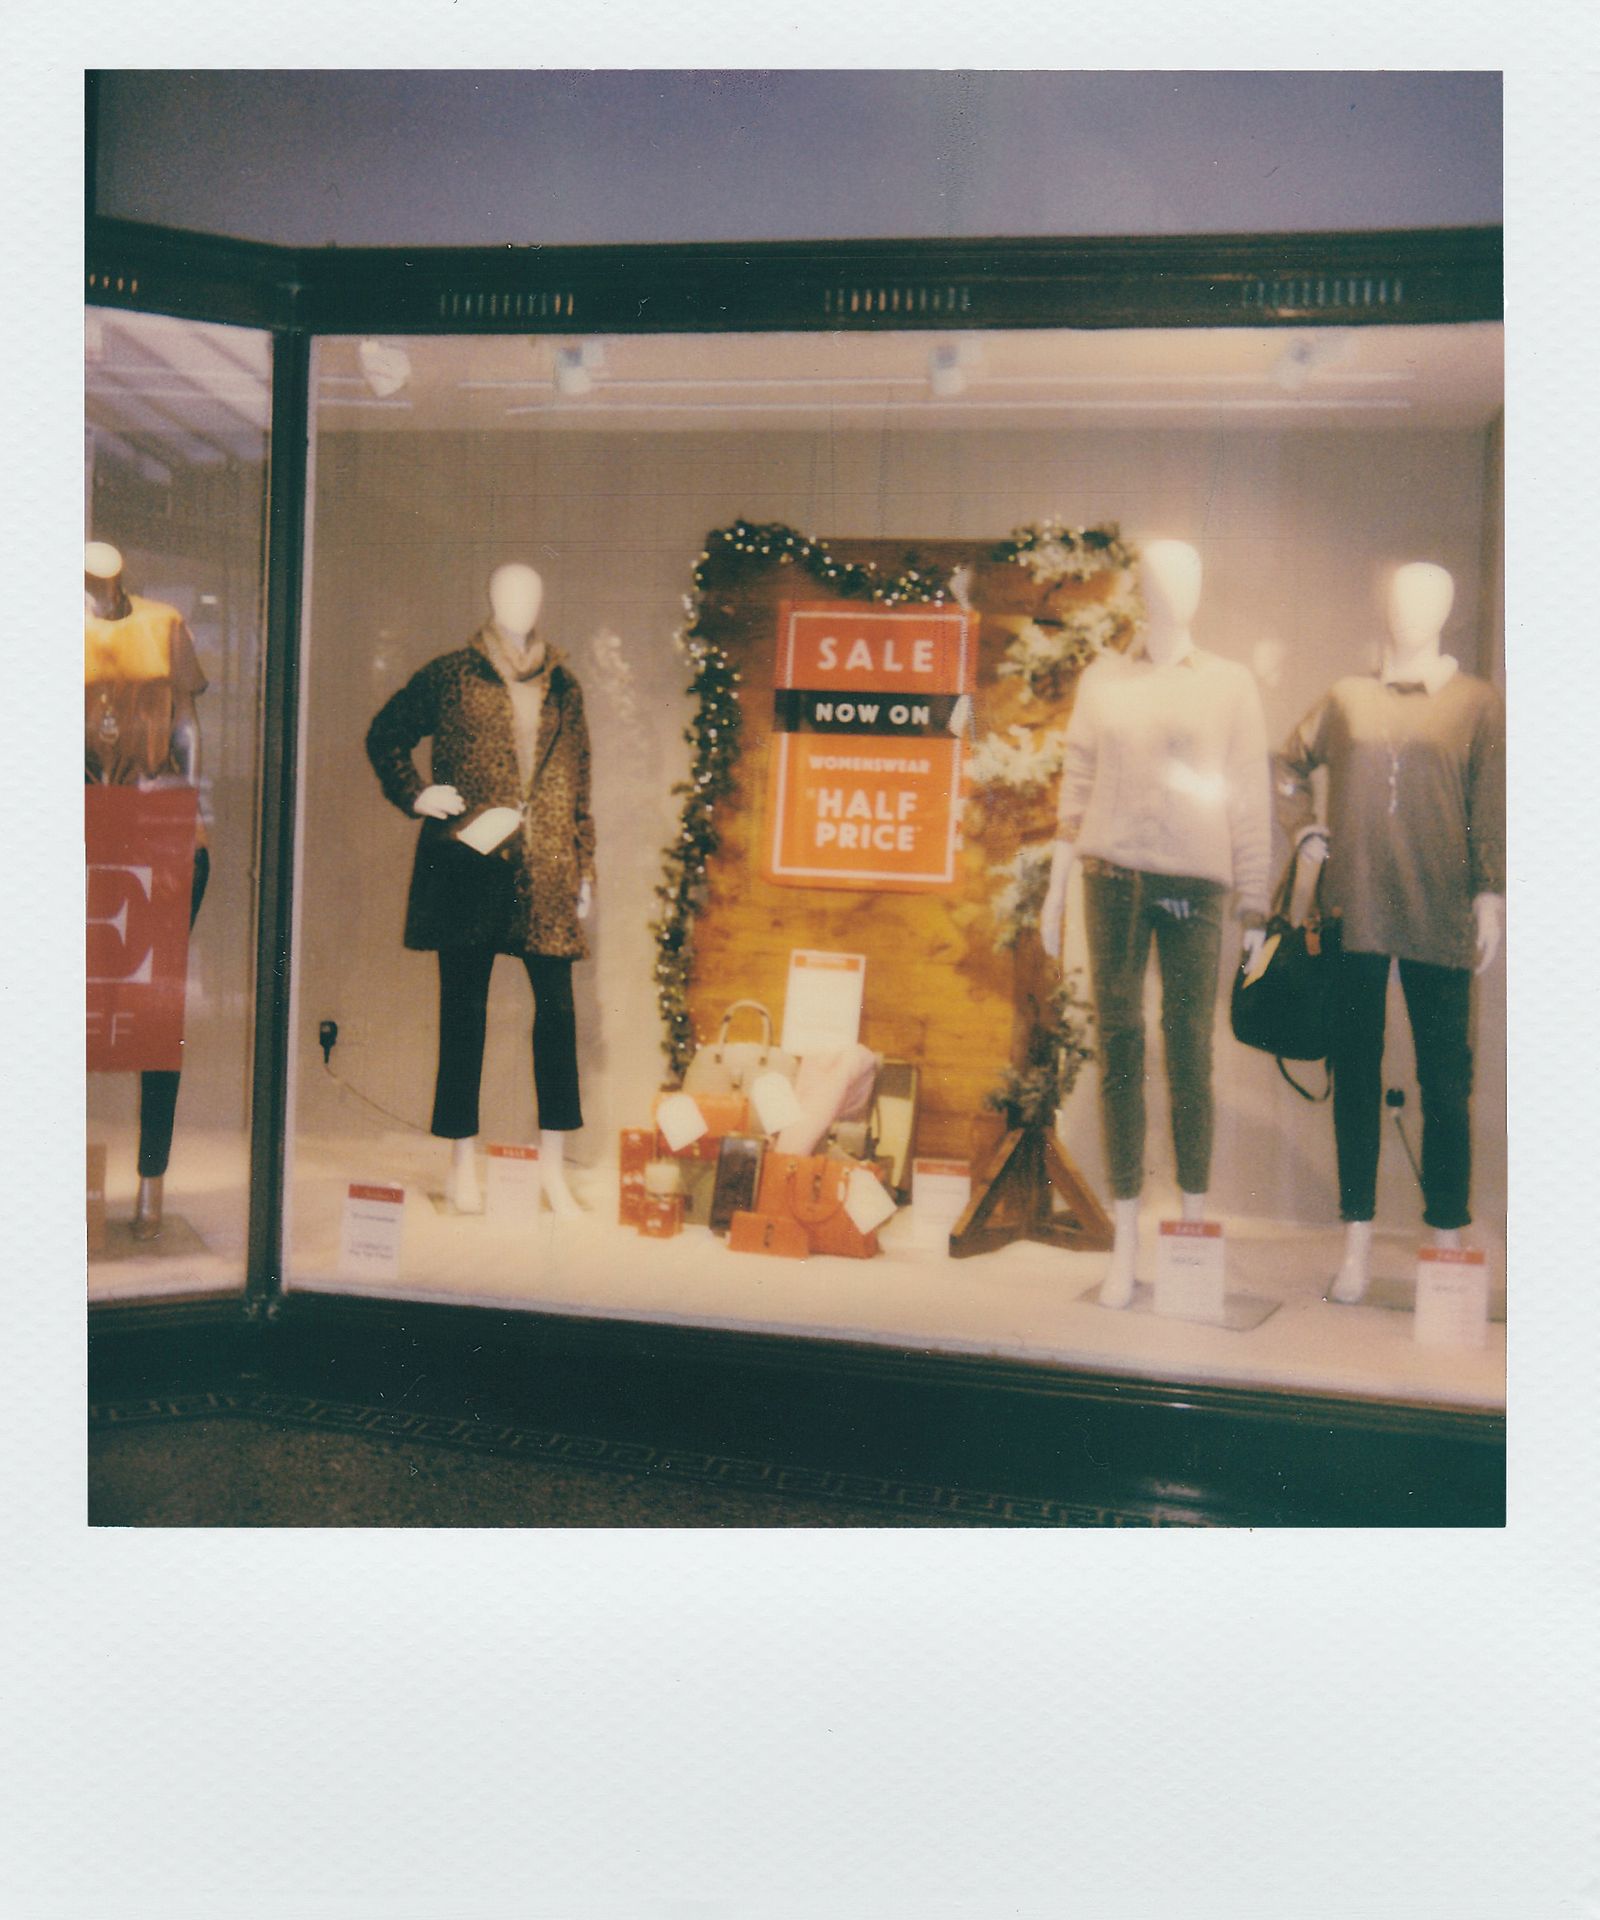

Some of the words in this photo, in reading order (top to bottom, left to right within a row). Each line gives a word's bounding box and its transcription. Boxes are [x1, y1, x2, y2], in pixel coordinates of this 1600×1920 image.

[817, 636, 934, 673] SALE
[815, 702, 879, 723] NOW
[888, 704, 930, 725] ON
[808, 755, 931, 775] WOMENSWEAR
[816, 787, 918, 821] HALF
